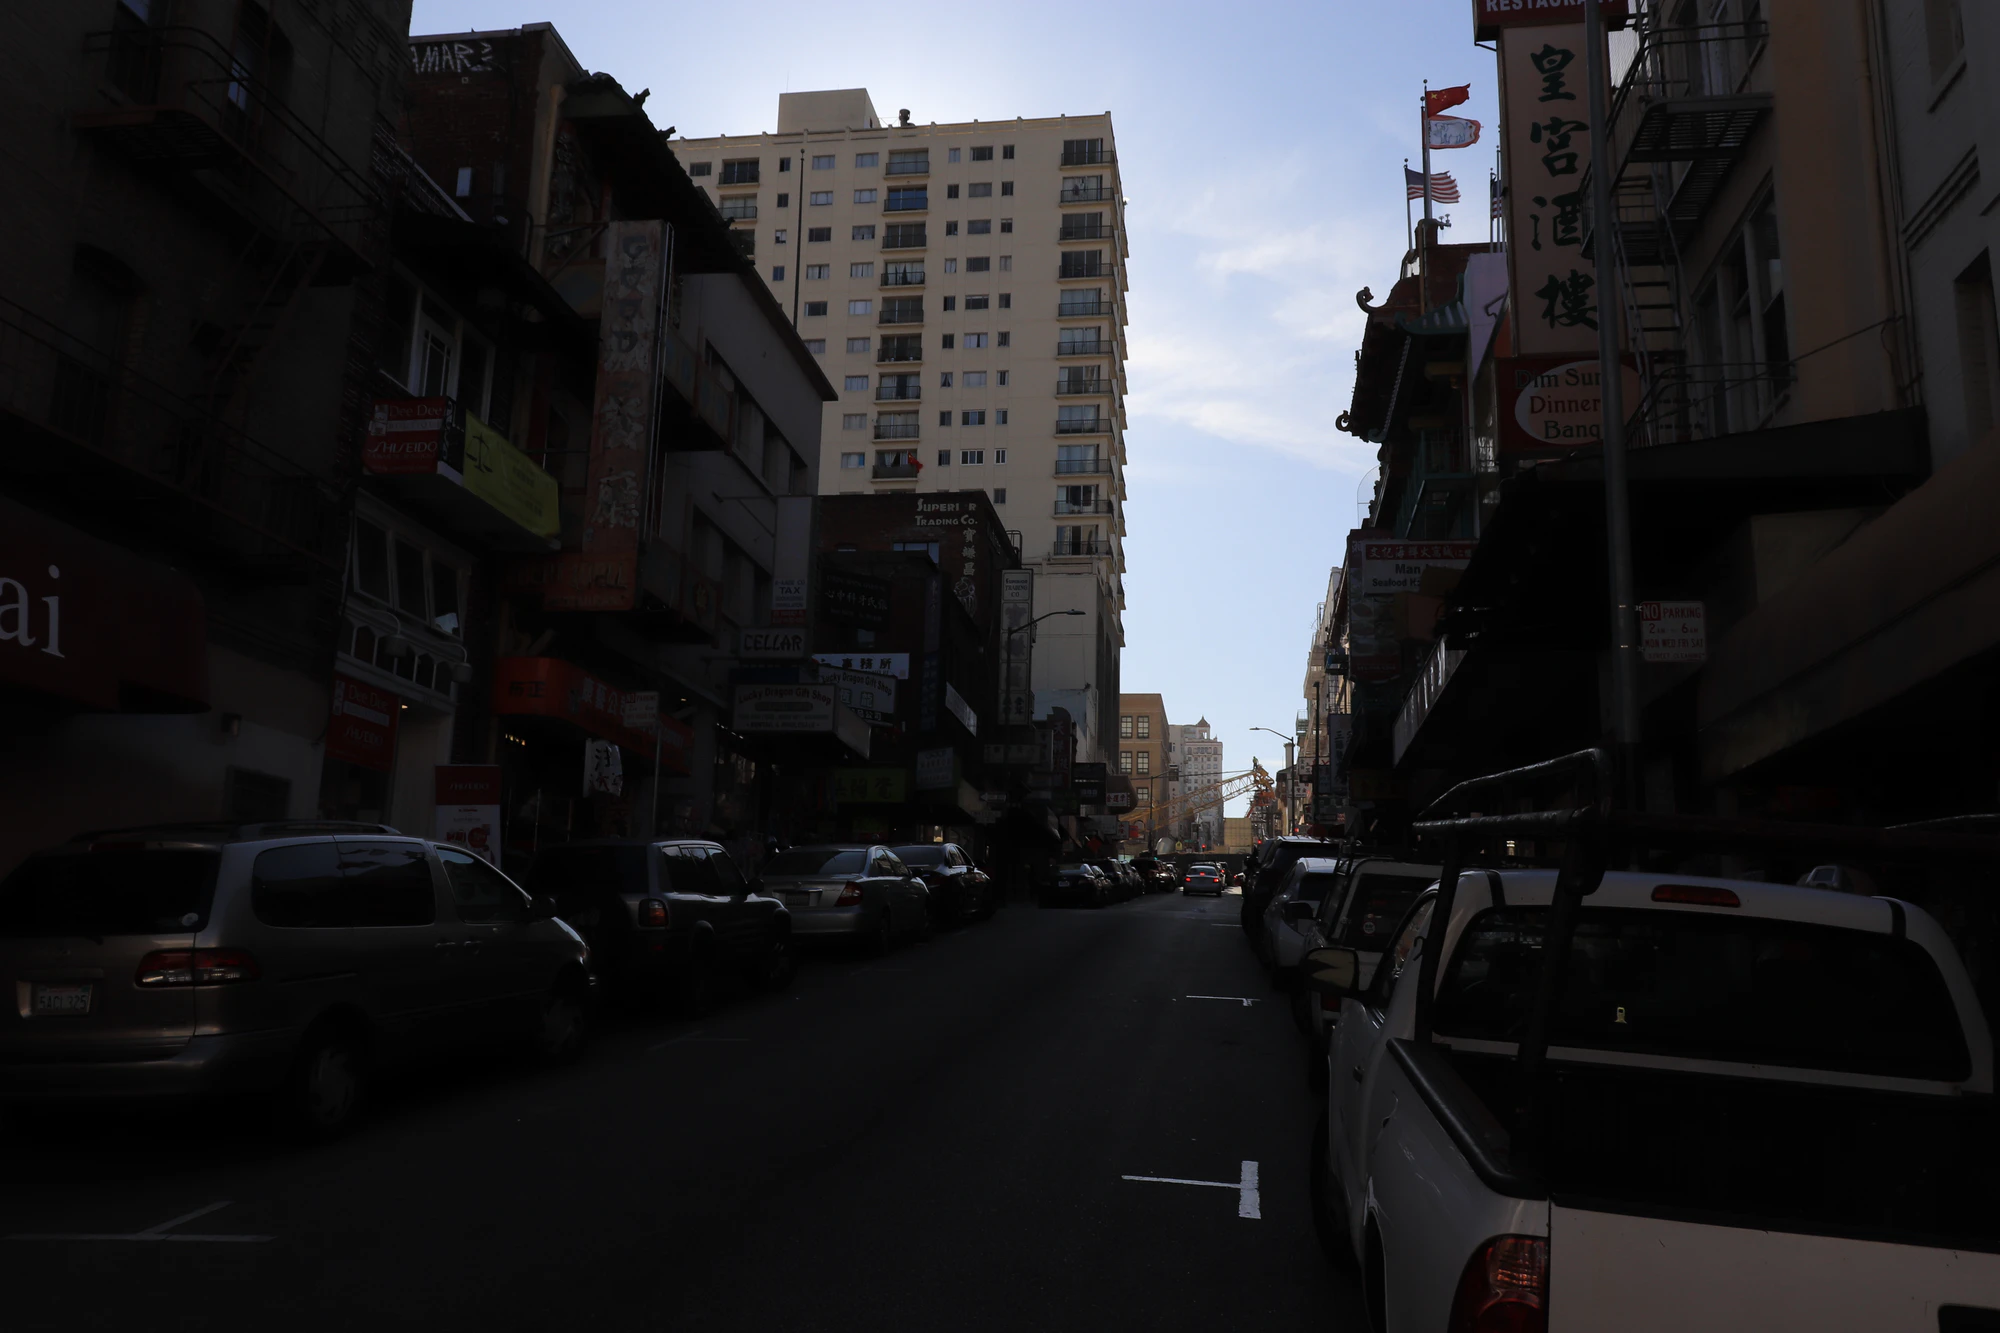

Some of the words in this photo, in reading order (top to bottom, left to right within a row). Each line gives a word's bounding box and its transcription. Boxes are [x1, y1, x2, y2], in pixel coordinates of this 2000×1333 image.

[1531, 44, 1598, 330] 皇宮酒樓
[1515, 369, 1559, 388] Dim
[390, 405, 413, 417] Dee
[417, 404, 442, 416] Dee
[1529, 395, 1601, 414] Dinner
[367, 441, 438, 453] SHISEIDO
[1395, 563, 1421, 574] Man
[1372, 578, 1407, 587] Seafood
[1643, 604, 1659, 619] NO
[1663, 607, 1702, 619] PARKING
[744, 634, 803, 651] CELLAR
[1644, 639, 1659, 648] MON
[1662, 639, 1676, 648] WED
[1678, 638, 1689, 648] FRI
[1691, 638, 1704, 648] SAT
[842, 671, 865, 685] Dragon
[865, 676, 877, 688] Gift
[877, 680, 892, 696] Shop
[348, 684, 368, 705] Dee
[369, 692, 389, 711] Dee
[738, 688, 763, 704] Lucky
[764, 687, 794, 698] Dragon
[795, 687, 810, 698] Gift
[812, 690, 832, 706] Shop
